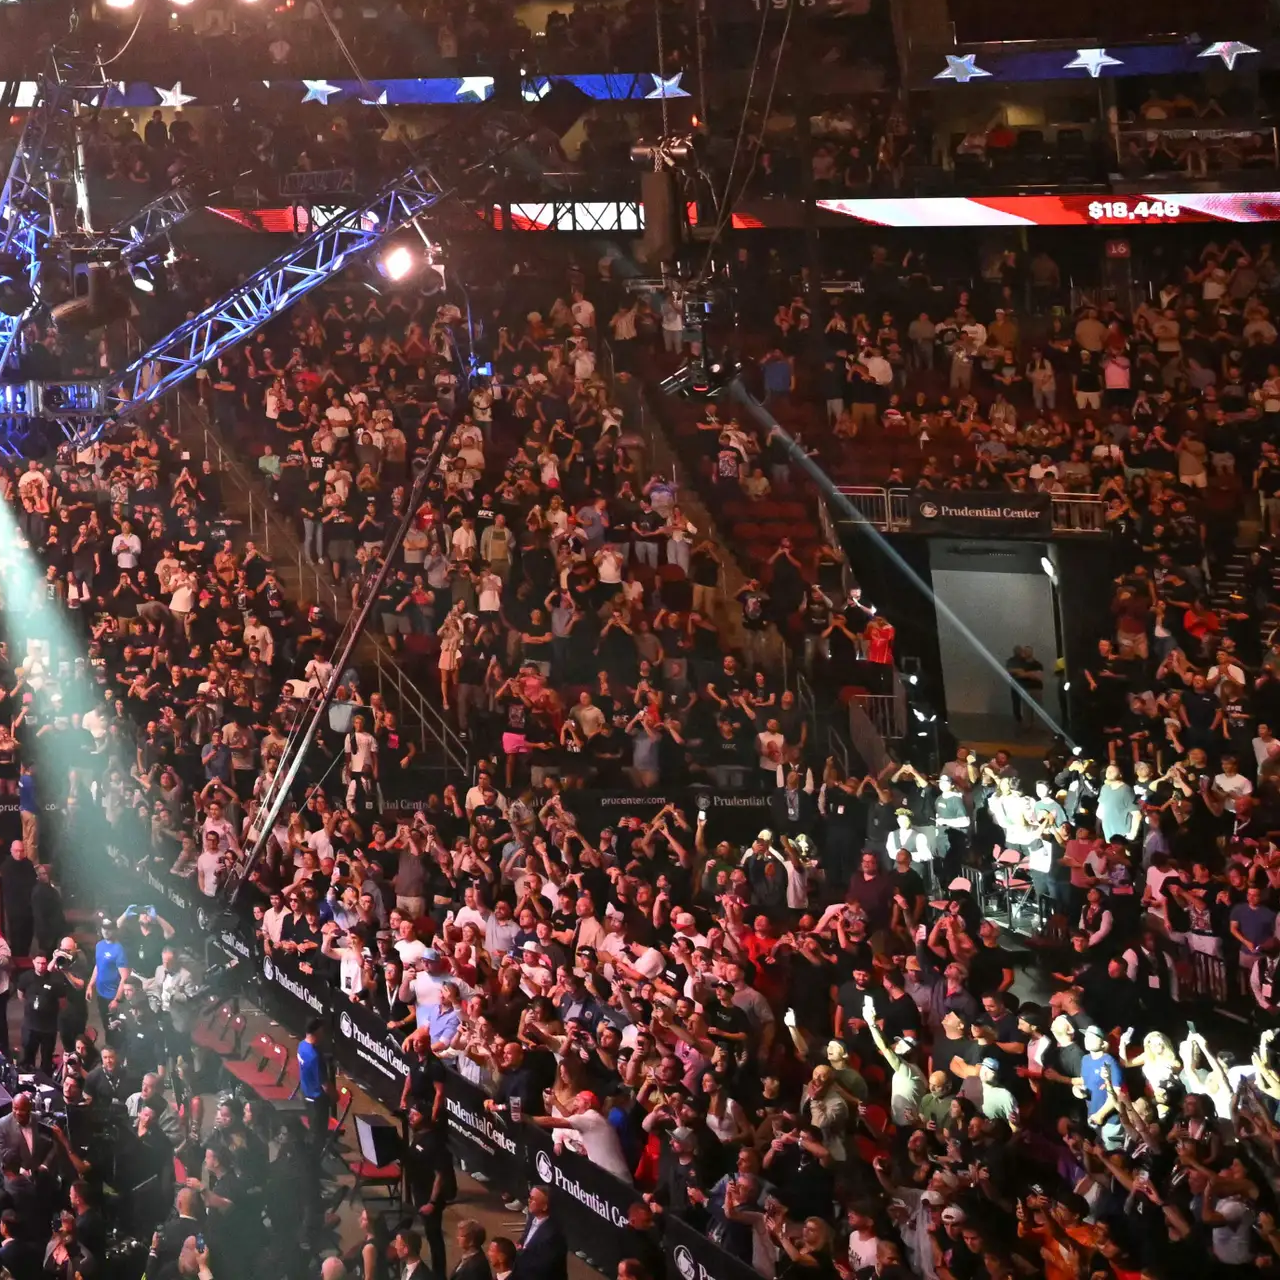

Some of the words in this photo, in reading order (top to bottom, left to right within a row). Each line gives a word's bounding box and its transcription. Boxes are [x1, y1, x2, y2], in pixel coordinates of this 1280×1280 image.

[1111, 244, 1127, 254] 16
[941, 505, 1001, 519] Prudential
[1003, 507, 1041, 520] Center
[713, 796, 766, 807] Prudential
[352, 1022, 389, 1064] Prudential
[446, 1096, 487, 1136] rudential
[486, 1122, 517, 1156] Center
[553, 1165, 611, 1223] Prudential
